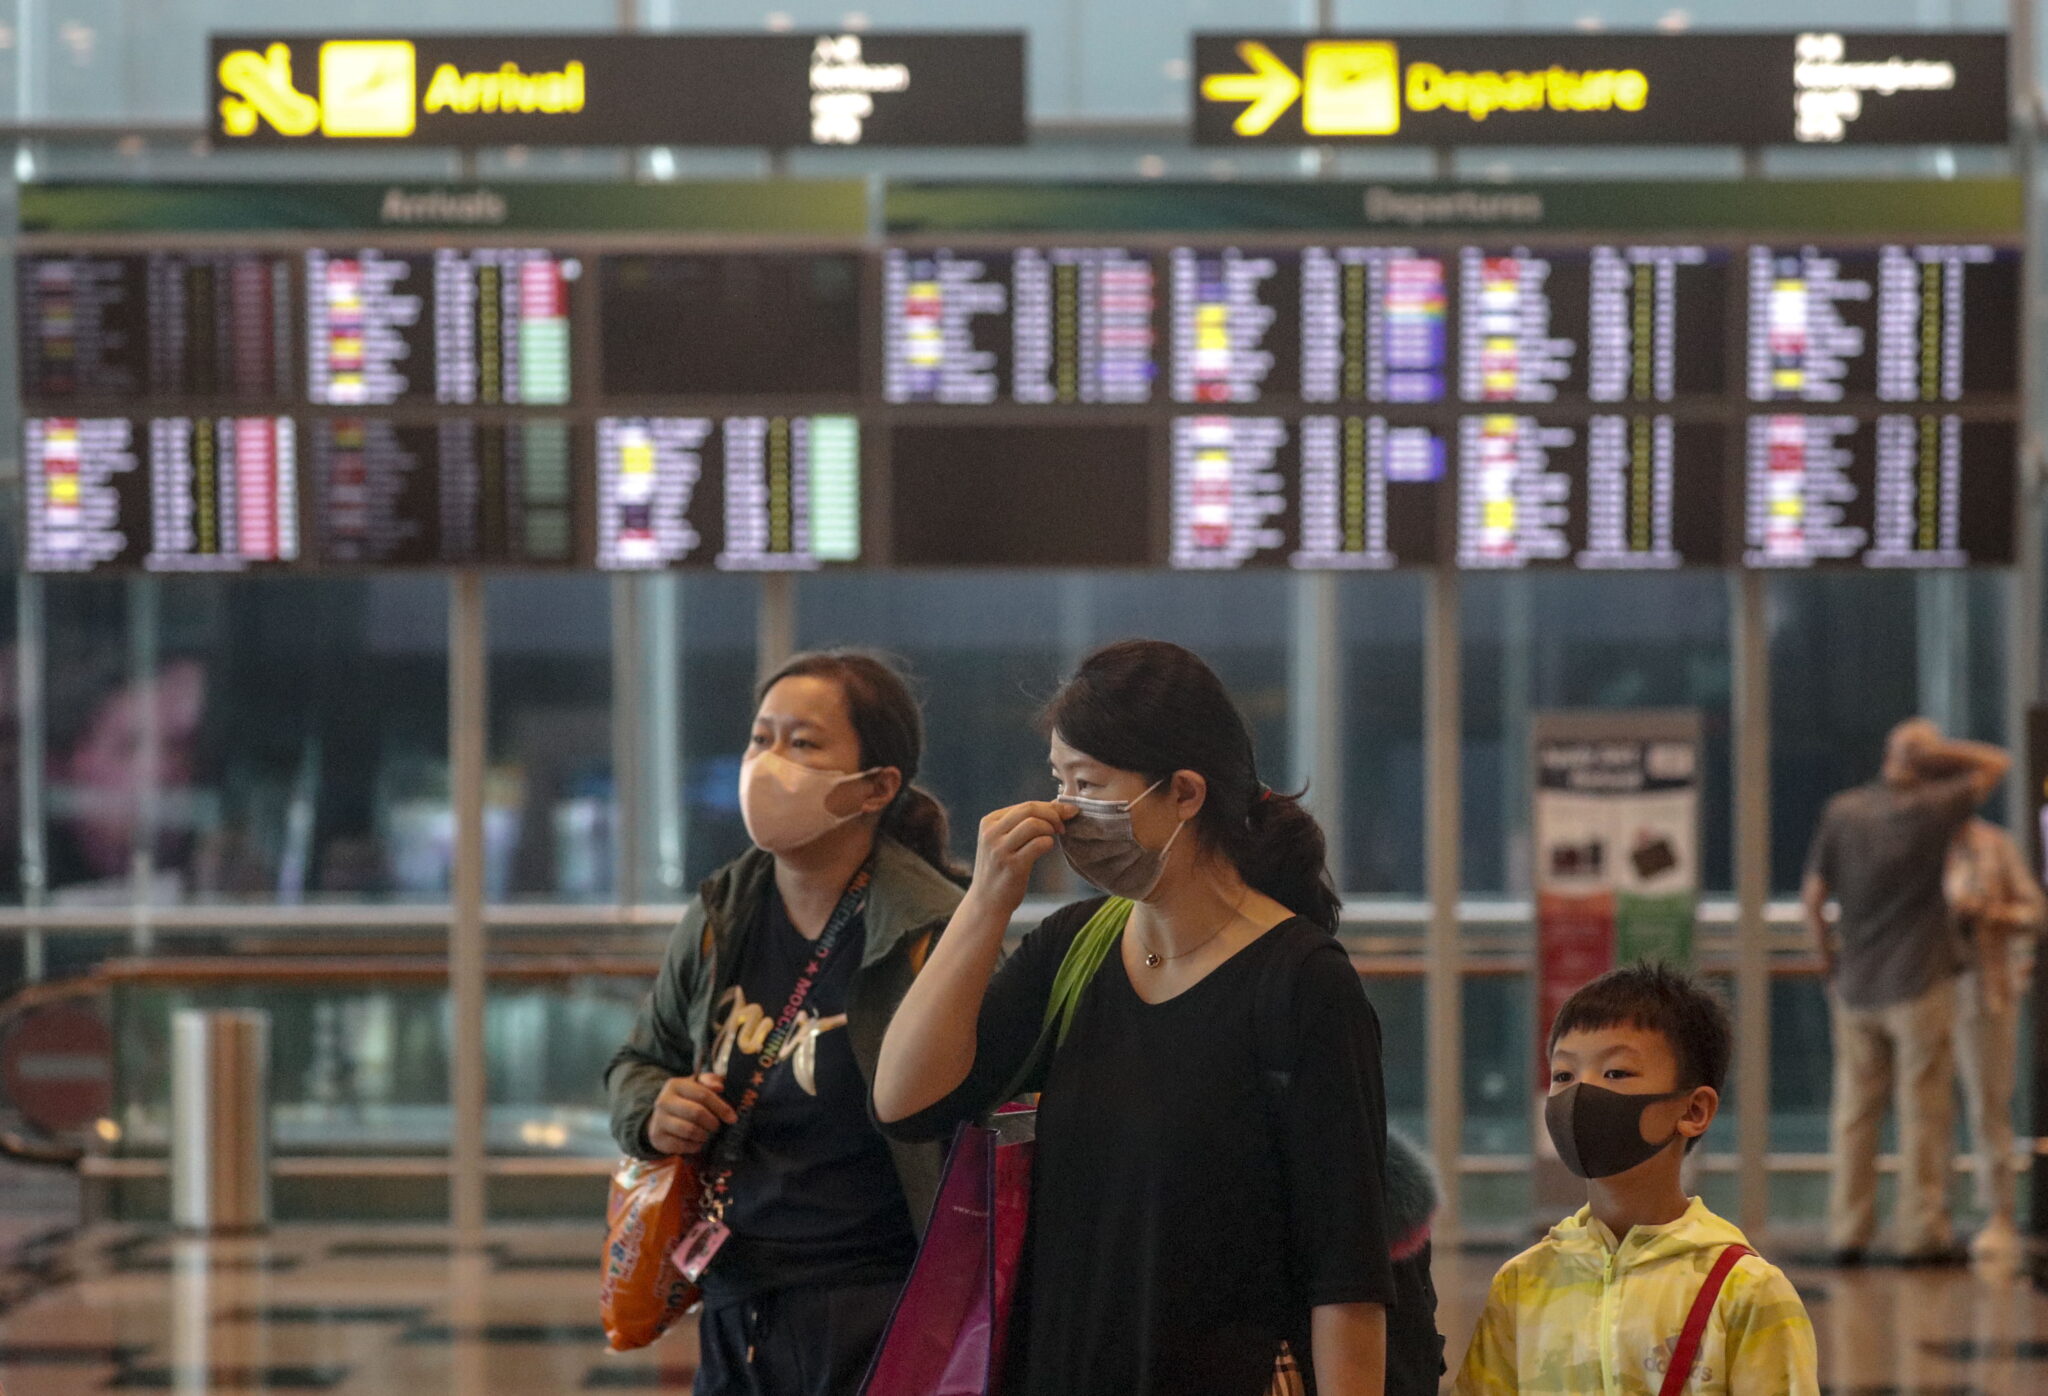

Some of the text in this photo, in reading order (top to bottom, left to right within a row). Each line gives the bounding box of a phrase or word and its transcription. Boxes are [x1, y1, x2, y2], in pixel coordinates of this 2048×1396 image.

[424, 61, 585, 114] Arrival
[1405, 62, 1648, 121] Departure
[382, 188, 506, 222] Arrivals
[1364, 187, 1543, 223] Departures
[758, 976, 812, 1068] MOSCHINO
